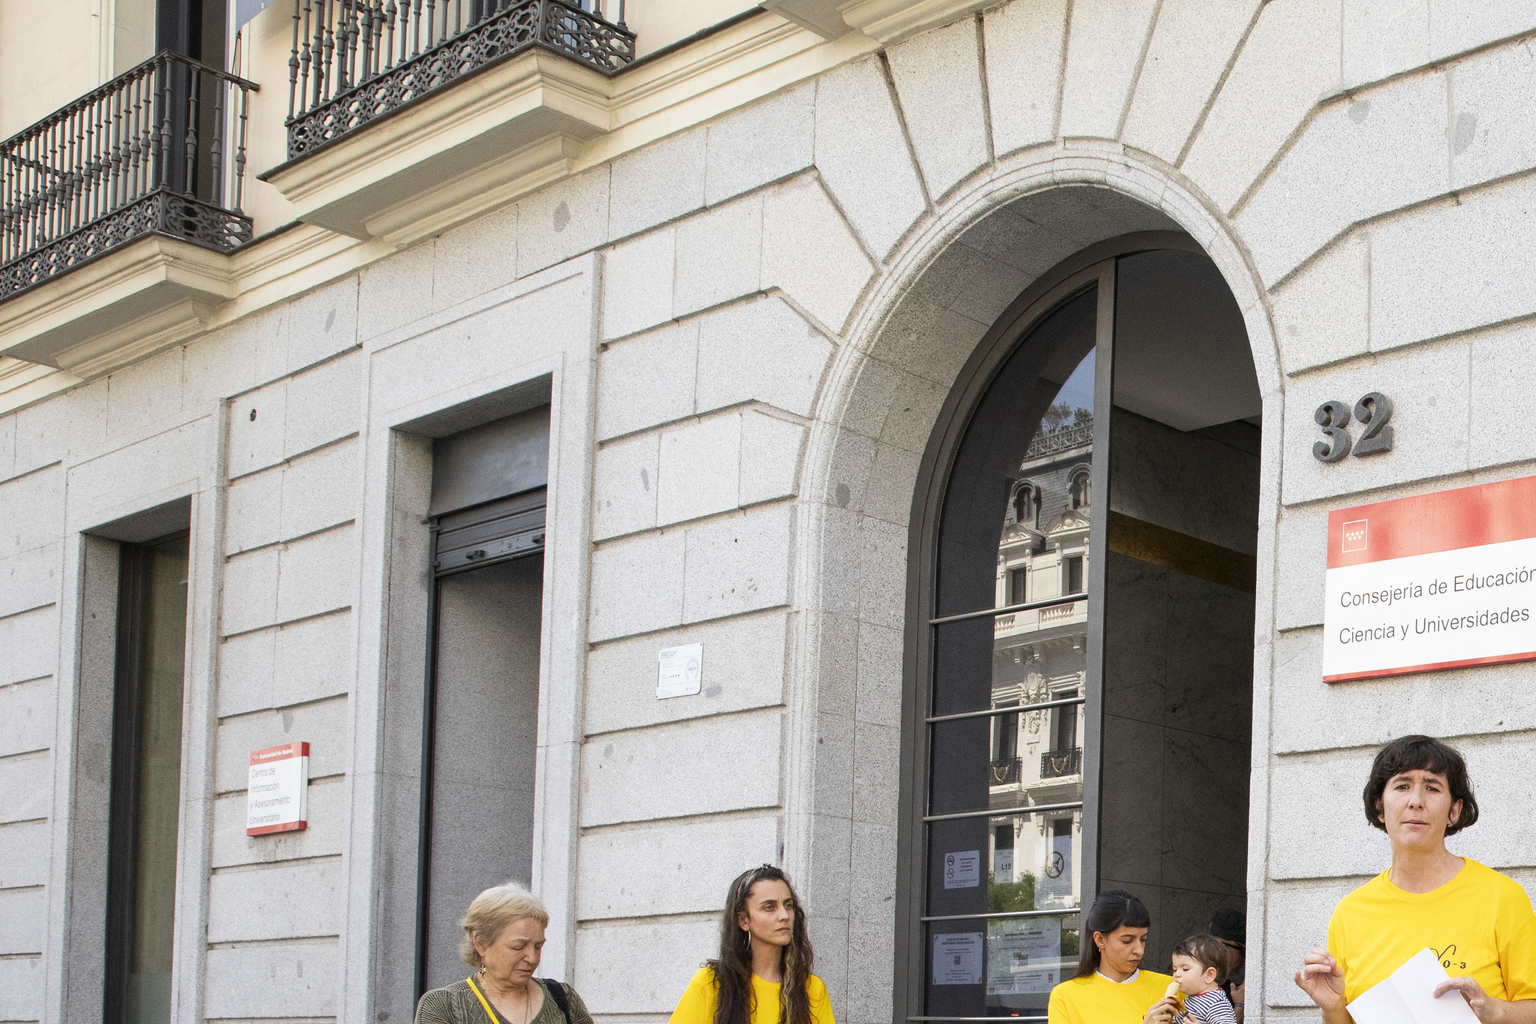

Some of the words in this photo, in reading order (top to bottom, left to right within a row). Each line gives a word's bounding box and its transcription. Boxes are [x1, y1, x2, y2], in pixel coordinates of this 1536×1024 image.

[1312, 391, 1394, 463] 32
[1340, 581, 1423, 608] Consejería
[1428, 578, 1448, 596] de
[1339, 621, 1396, 645] Ciencia
[1401, 622, 1410, 640] y
[1414, 606, 1531, 635] Universidades
